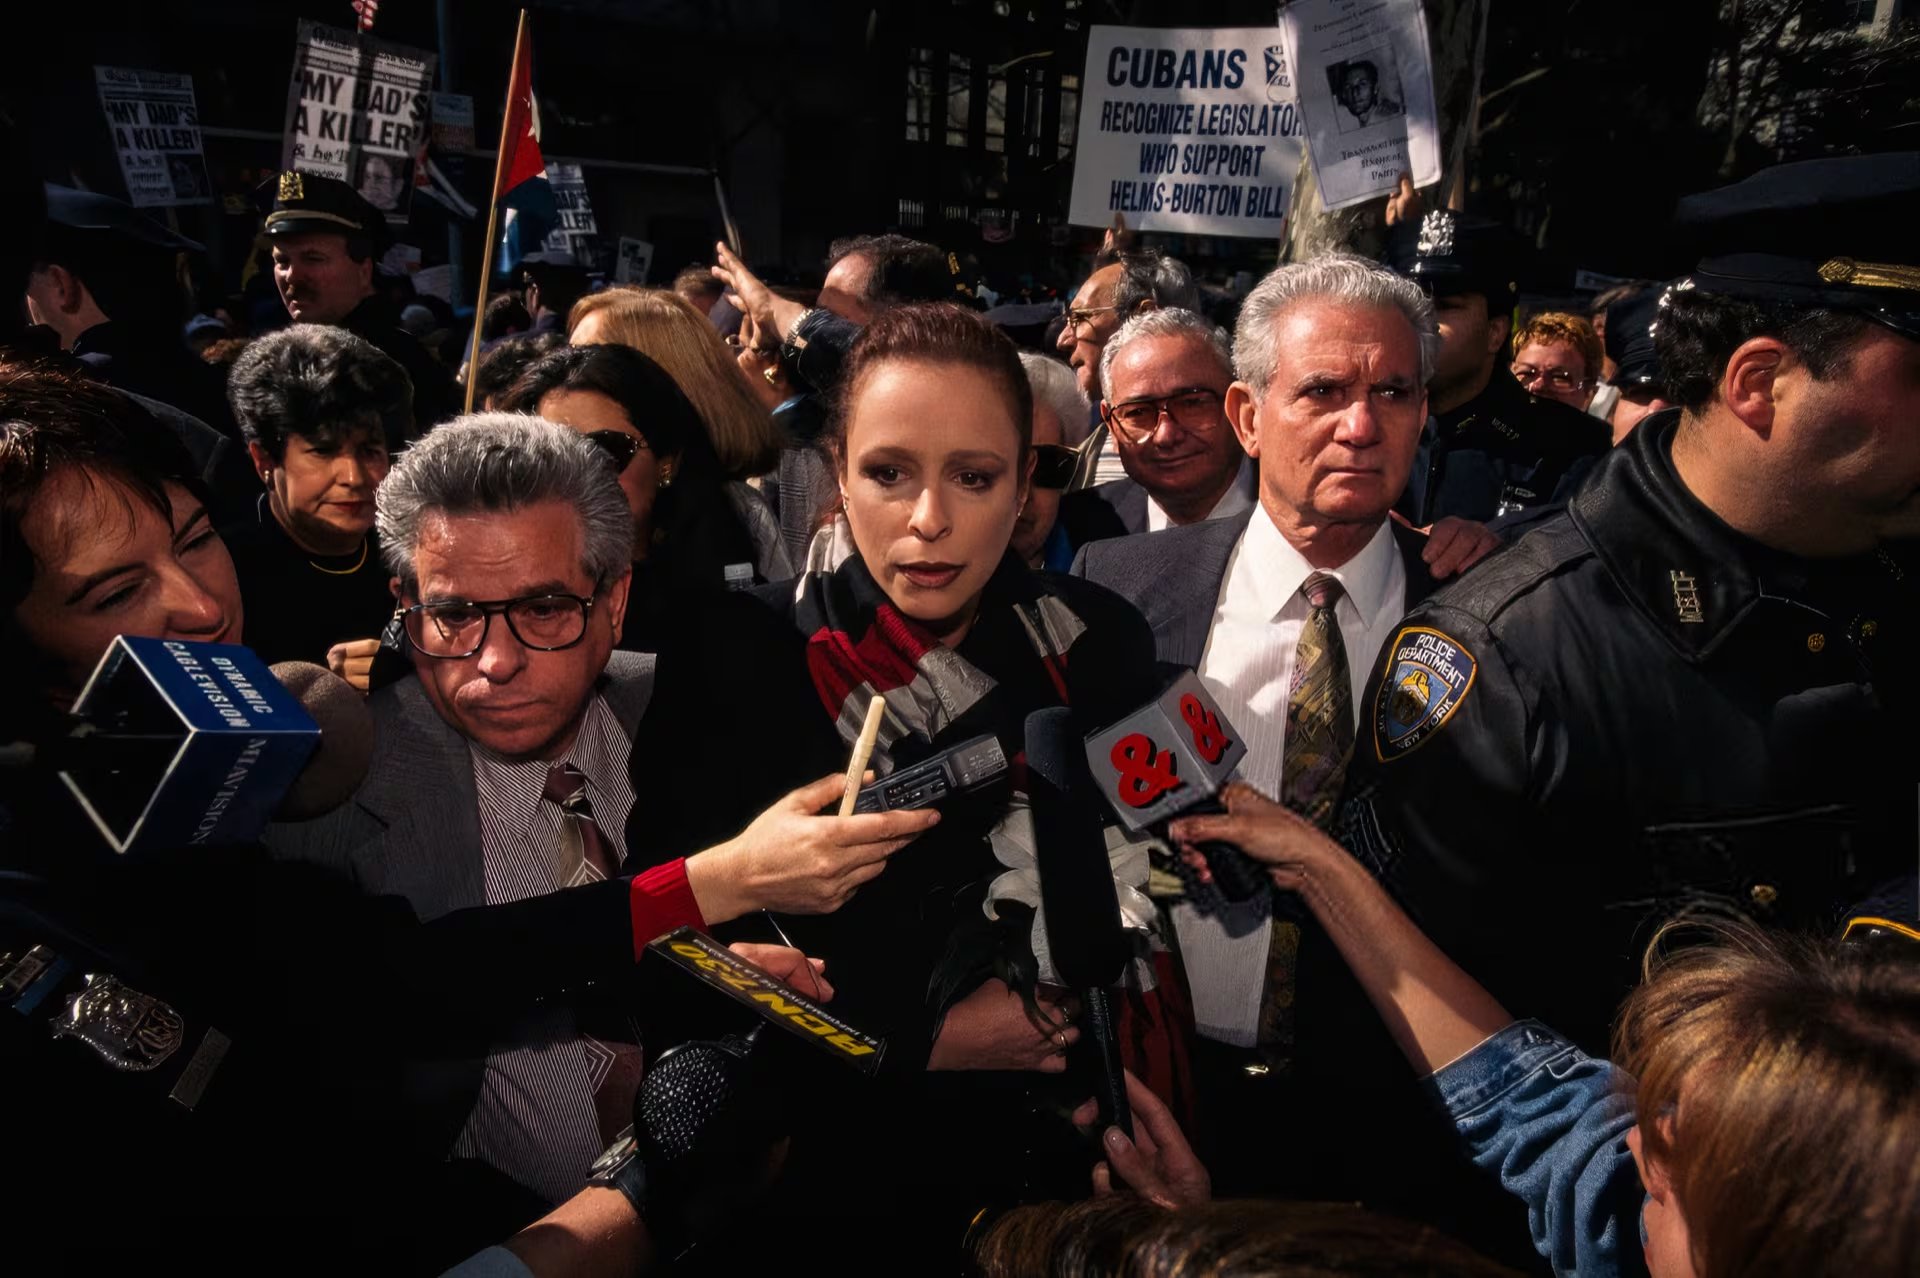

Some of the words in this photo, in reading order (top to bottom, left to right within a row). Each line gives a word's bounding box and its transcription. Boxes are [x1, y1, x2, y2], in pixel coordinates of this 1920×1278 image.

[1107, 46, 1247, 89] CUBANS
[290, 106, 309, 136] A
[353, 81, 428, 122] DAD'S
[1101, 101, 1195, 135] RECOGNIZE
[115, 127, 131, 149] A
[1138, 142, 1178, 175] WHO
[1181, 143, 1266, 178] SUPPORT
[1109, 180, 1243, 215] HELMS-BURTON
[1245, 185, 1285, 220] BILL
[1397, 646, 1465, 689] DEPARTMENT
[1415, 634, 1457, 661] POLICE
[163, 641, 251, 728] CABLEVISION
[211, 657, 274, 714] DYNAMIC
[1423, 698, 1454, 732] YORK
[748, 991, 876, 1056] RCN
